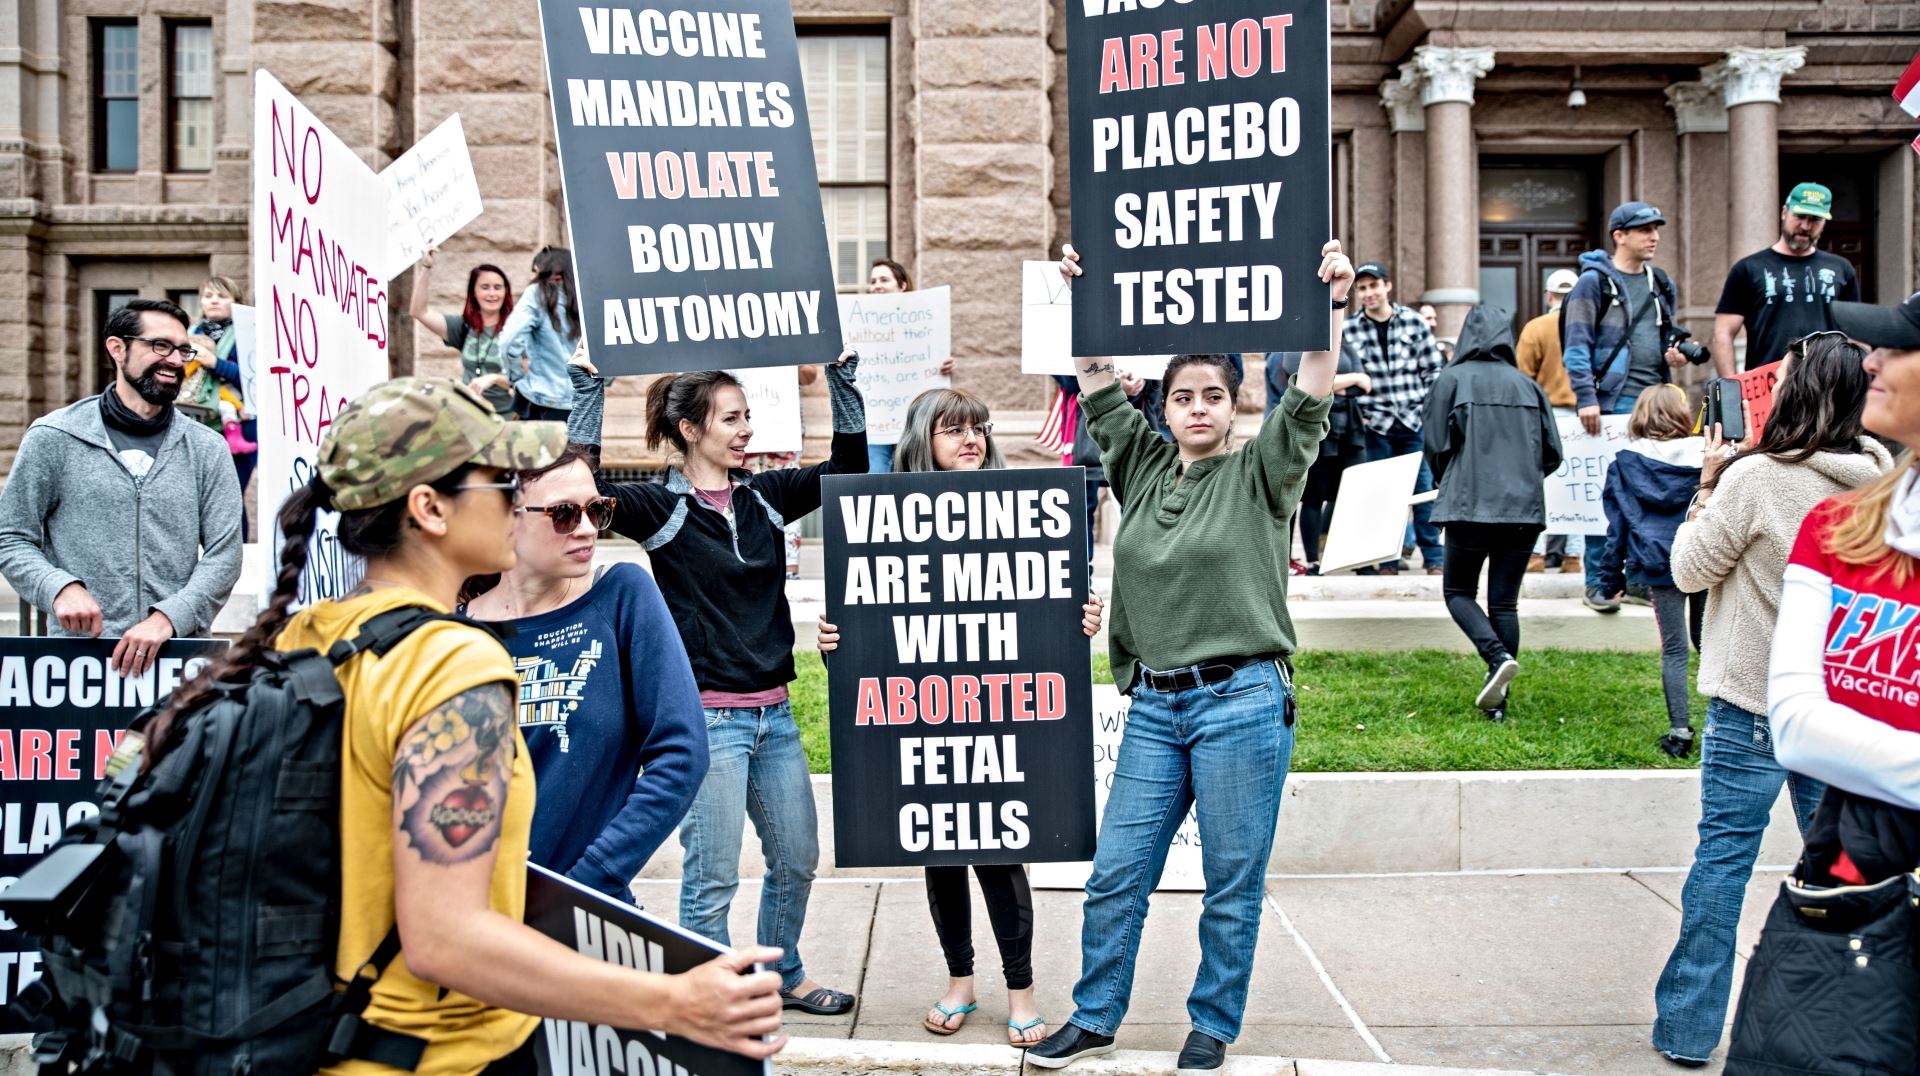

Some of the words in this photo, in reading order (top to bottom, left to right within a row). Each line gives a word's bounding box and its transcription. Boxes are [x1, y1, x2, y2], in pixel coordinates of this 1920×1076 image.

[578, 6, 767, 58] VACCINE
[1099, 28, 1185, 94] ARE
[1196, 13, 1292, 81] NOT
[566, 78, 795, 129] MANDATES
[270, 98, 323, 204] NO
[1092, 96, 1301, 173] PLACEBO
[605, 150, 780, 200] VIOLATE
[1114, 181, 1283, 249] SAFETY
[270, 191, 387, 349] MANDATES
[627, 222, 775, 274] BODILY
[603, 290, 821, 345] AUTONOMY
[849, 299, 933, 326] Americans
[1113, 264, 1283, 326] TESTED
[273, 284, 318, 368] NO
[849, 331, 896, 343] without
[904, 326, 934, 340] their
[857, 372, 890, 391] ights,
[895, 373, 920, 383] are
[859, 345, 931, 366] onstitutional
[270, 366, 347, 447] TRA
[839, 488, 1072, 544] VACCINES
[844, 554, 931, 605] ARE
[942, 550, 1073, 602] MADE
[534, 633, 566, 648] SHAPES
[567, 628, 589, 638] WHAT
[537, 621, 584, 641] EDUCATION
[551, 639, 569, 650] WILL
[571, 636, 581, 644] BE
[892, 612, 1019, 664] WITH
[855, 672, 1067, 726] ABORTED
[1830, 667, 1920, 707] Vaccine
[0, 728, 82, 781] ARE
[899, 734, 1026, 786] FETAL
[899, 799, 1030, 852] CELLS
